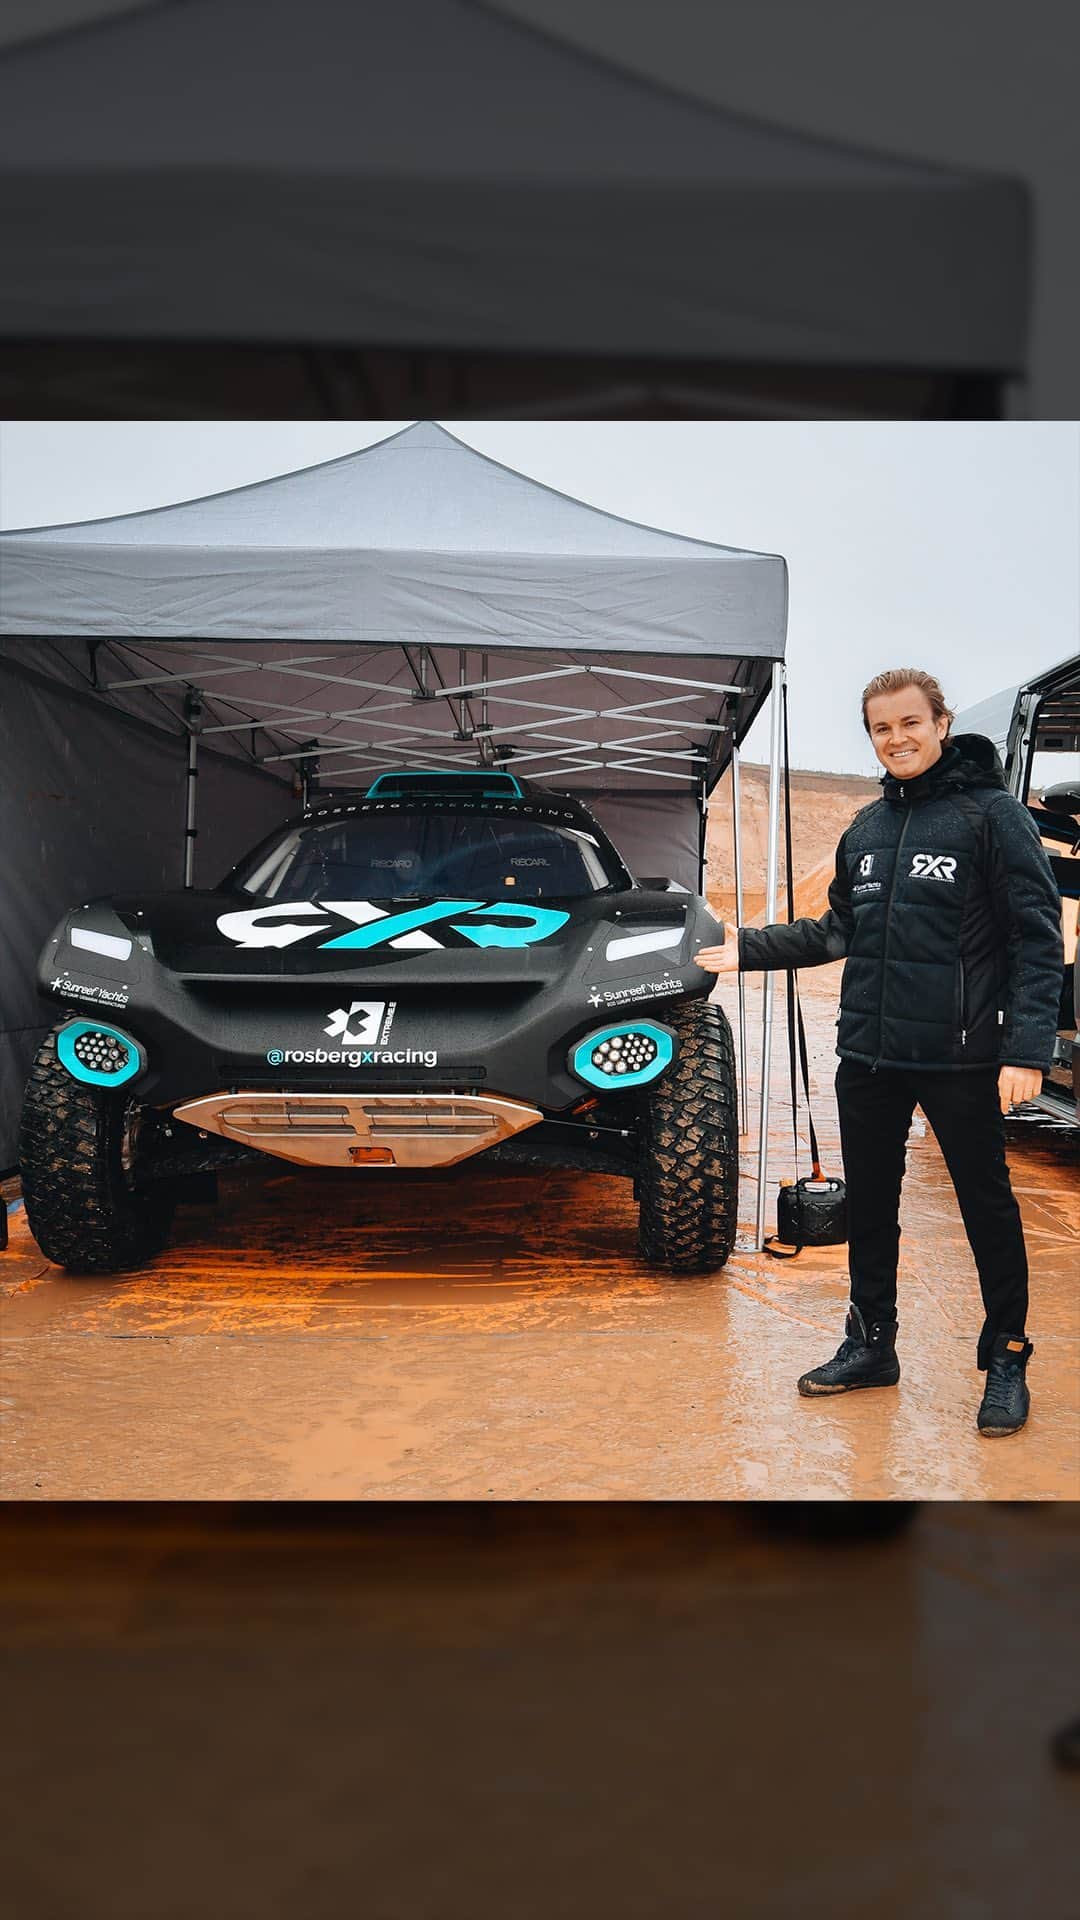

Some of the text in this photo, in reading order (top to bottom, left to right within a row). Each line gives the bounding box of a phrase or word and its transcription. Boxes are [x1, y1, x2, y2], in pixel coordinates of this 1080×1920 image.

[510, 857, 551, 867] RECAR
[62, 980, 99, 996] Sunreef
[98, 988, 129, 1003] Yachts
[603, 979, 683, 1001] Sunreef Yachts
[267, 1048, 437, 1068] @rosbergxracing
